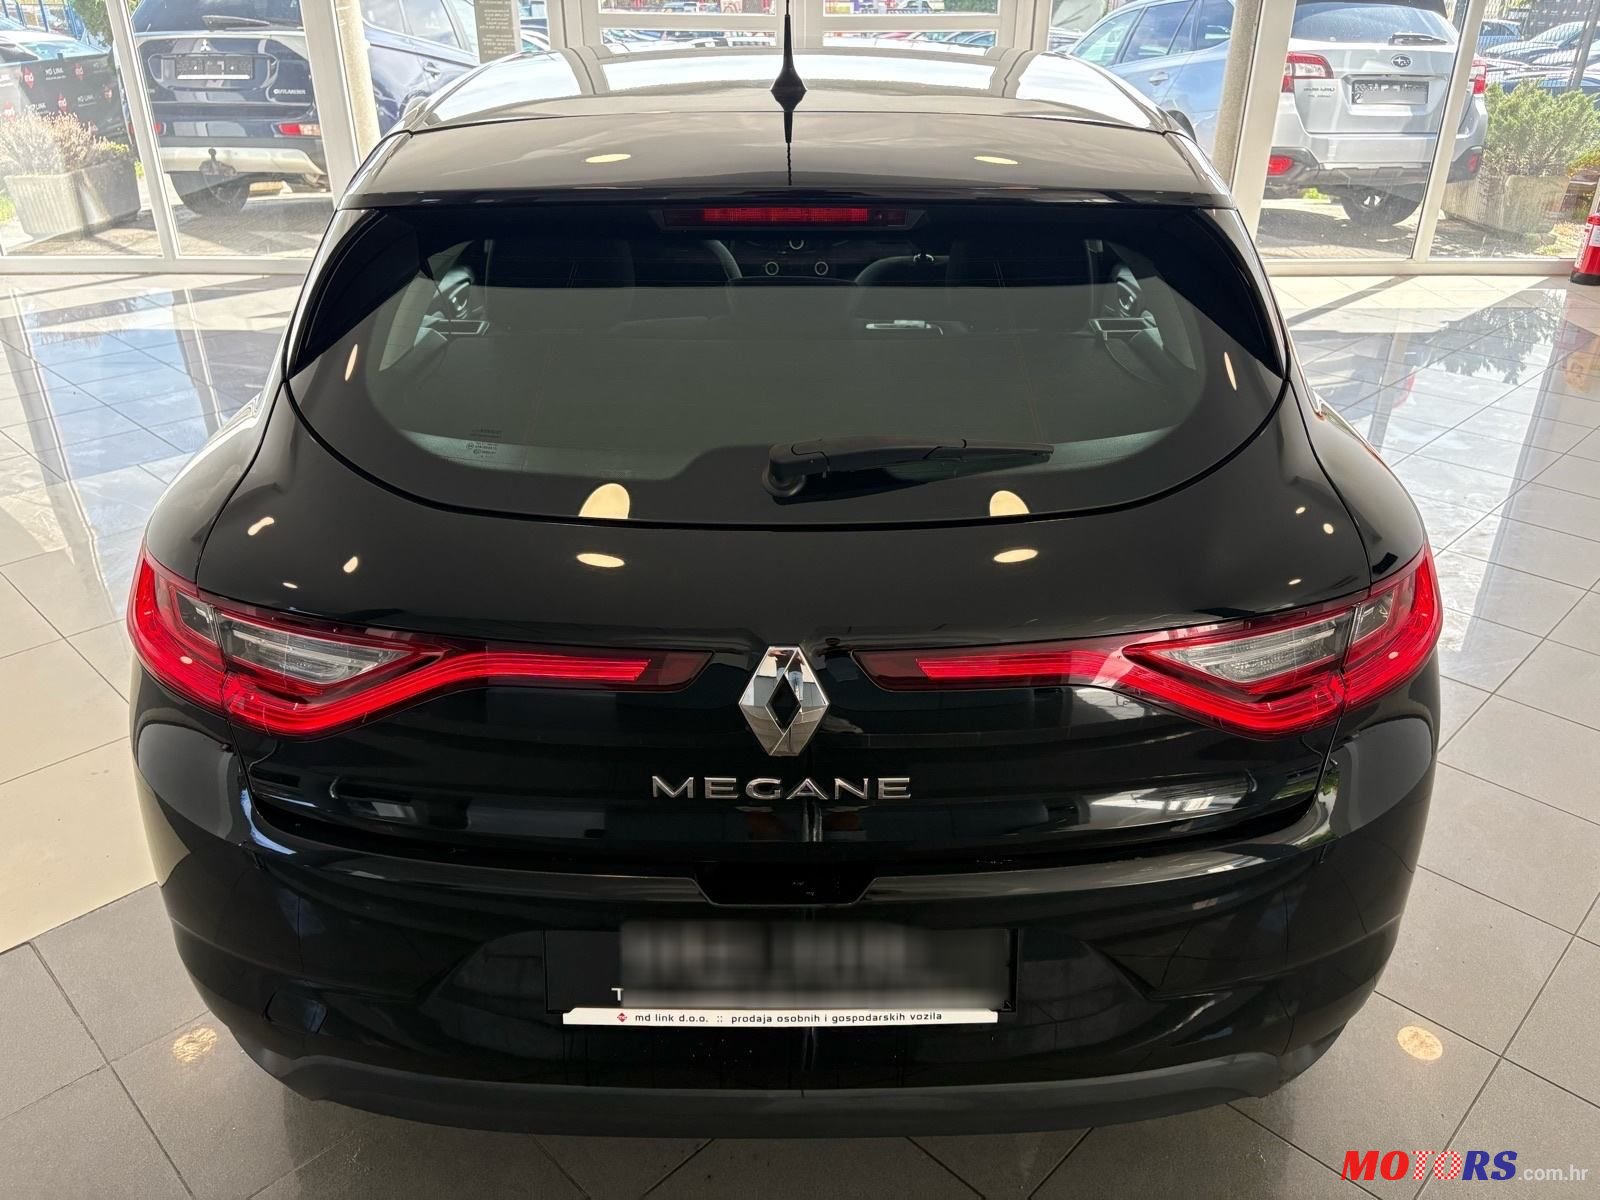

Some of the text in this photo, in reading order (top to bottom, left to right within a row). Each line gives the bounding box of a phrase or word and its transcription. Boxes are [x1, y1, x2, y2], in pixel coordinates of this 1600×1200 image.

[651, 775, 912, 801] MEGANE
[634, 1014, 651, 1023] md
[655, 1014, 674, 1023] link
[678, 1014, 709, 1023] d.o.o.
[731, 1014, 772, 1025] prodaja
[776, 1014, 820, 1023] osobnih
[823, 1014, 828, 1023] i
[831, 1012, 905, 1025] gospodarskih
[910, 1011, 943, 1022] vozila
